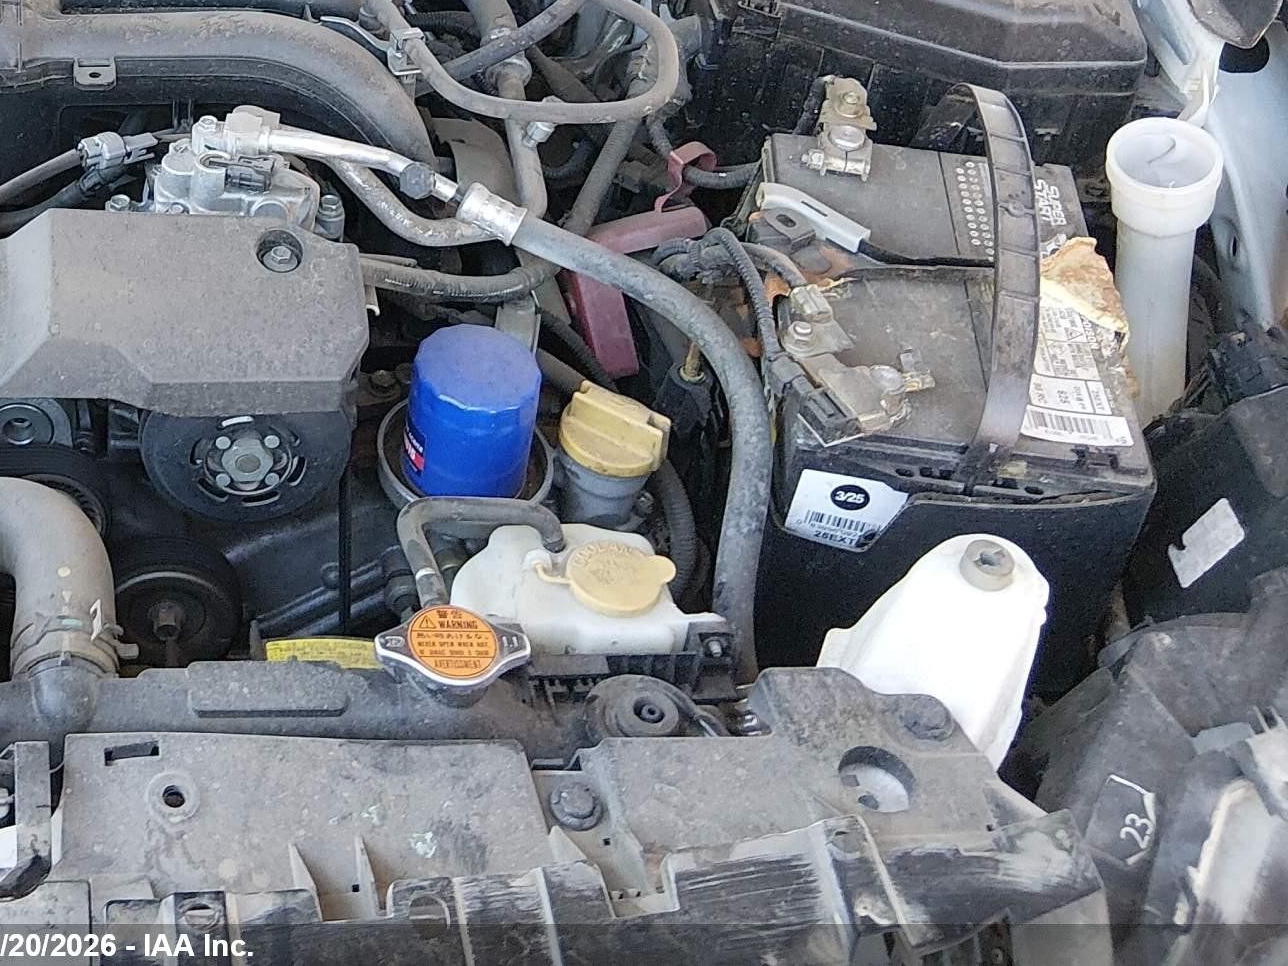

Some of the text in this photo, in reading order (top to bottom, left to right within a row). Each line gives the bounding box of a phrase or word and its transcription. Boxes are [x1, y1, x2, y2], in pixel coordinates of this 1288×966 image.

[1034, 179, 1053, 222] START
[1048, 185, 1067, 226] SUPER
[834, 490, 866, 504] 3/25
[438, 620, 479, 630] WARNING
[1119, 813, 1154, 849] 23
